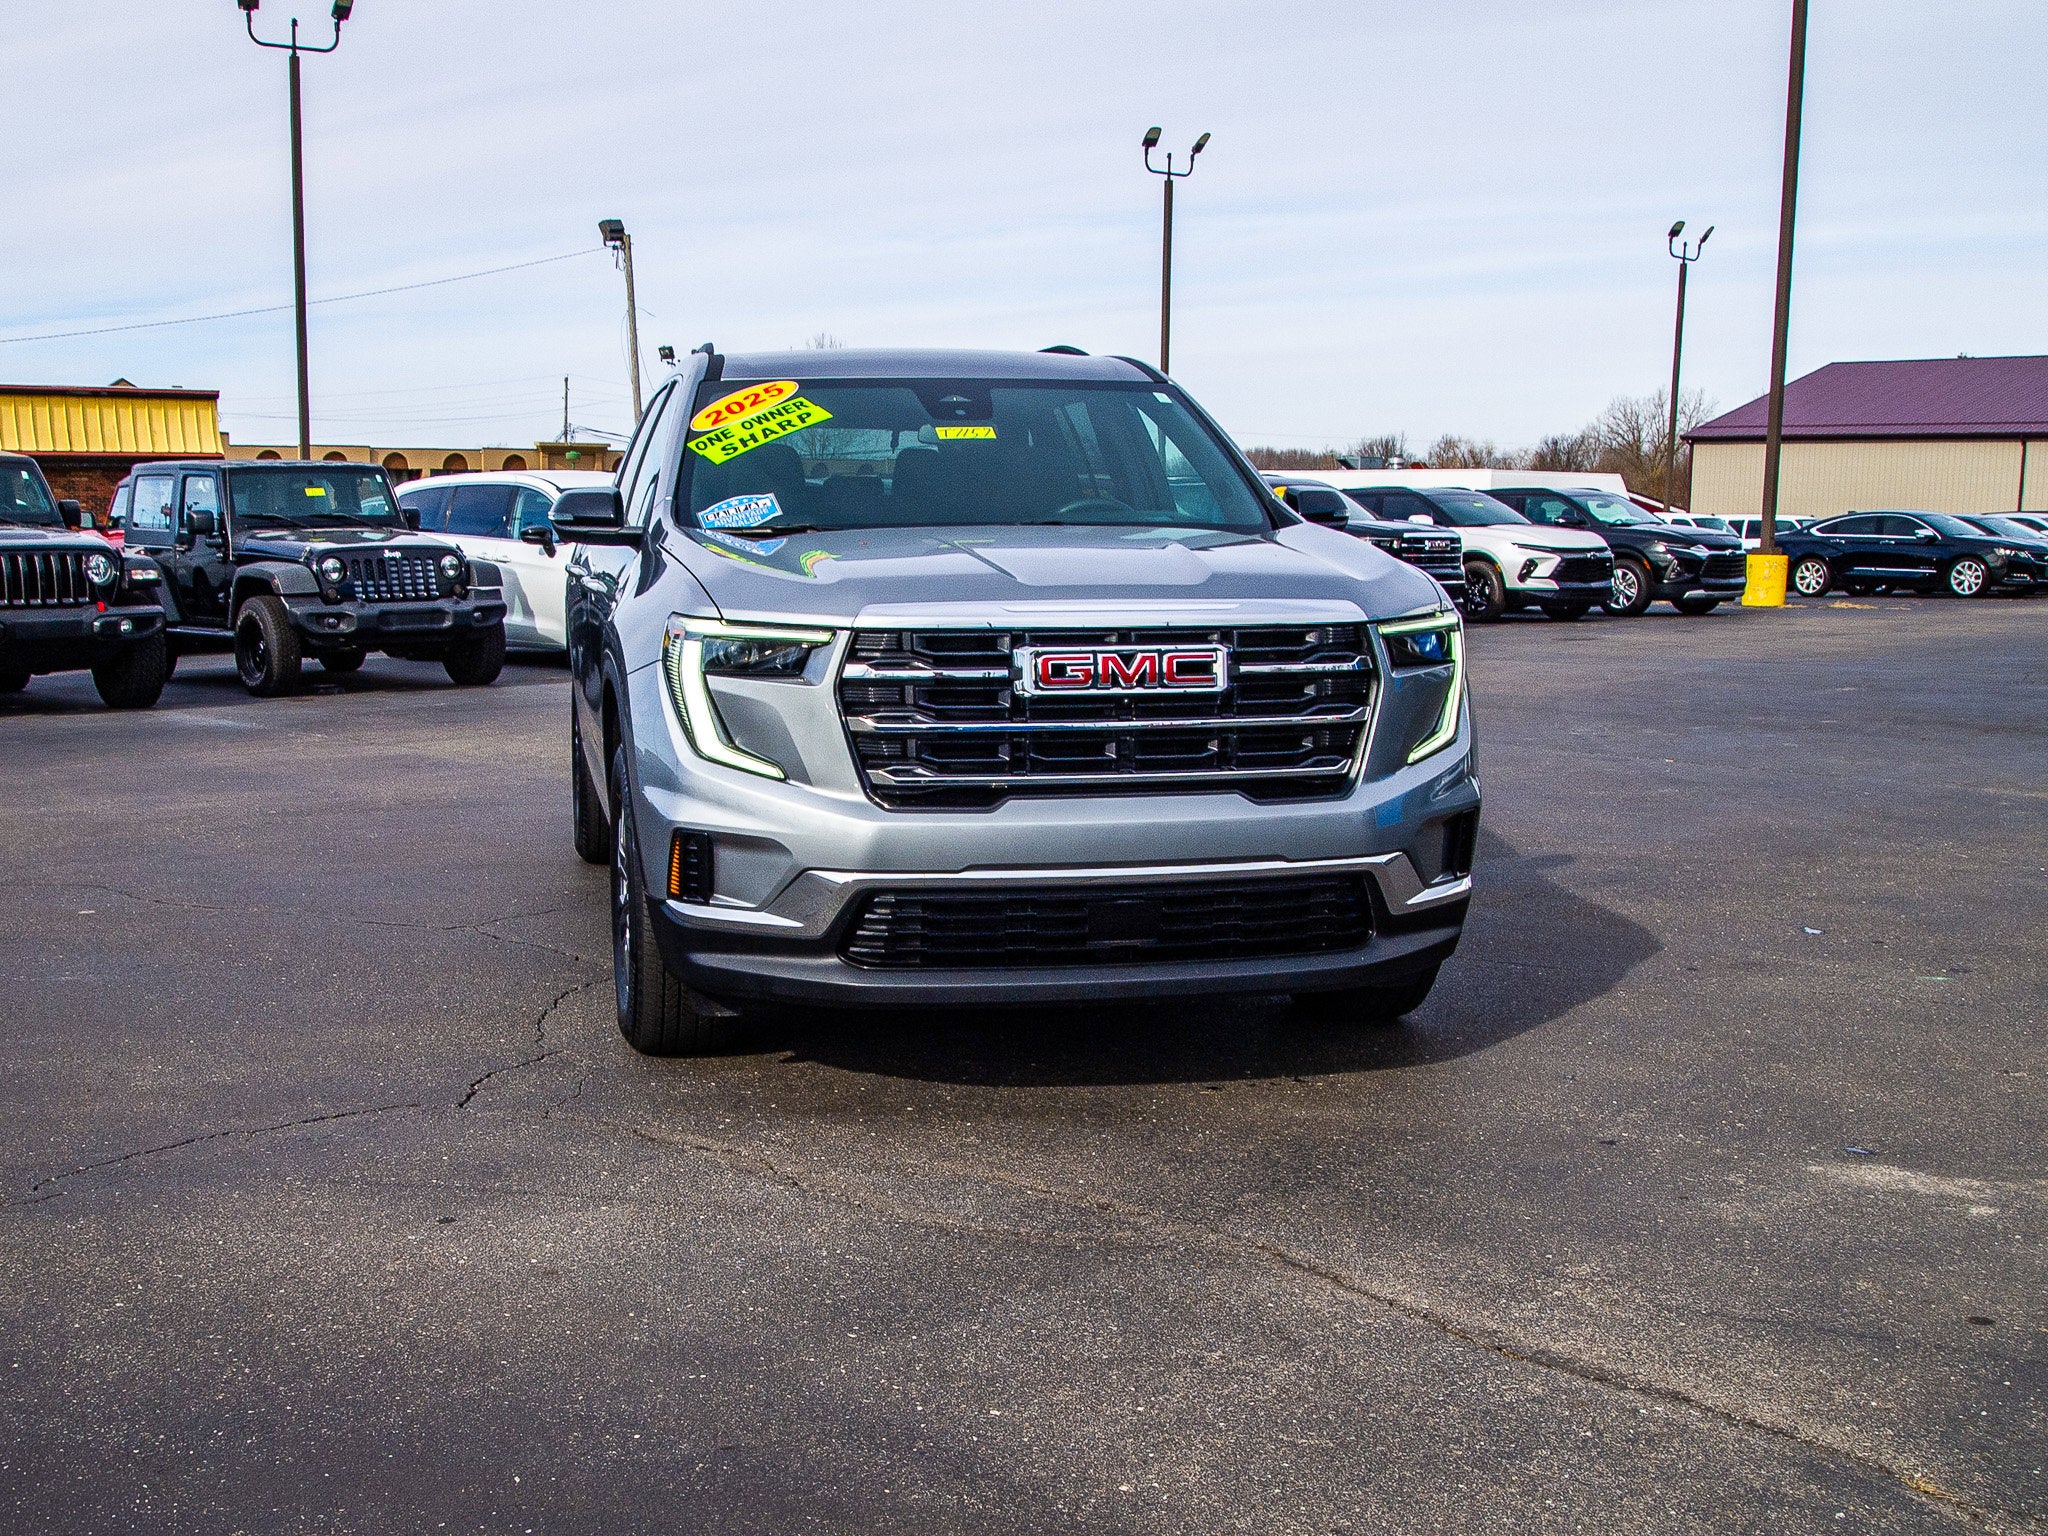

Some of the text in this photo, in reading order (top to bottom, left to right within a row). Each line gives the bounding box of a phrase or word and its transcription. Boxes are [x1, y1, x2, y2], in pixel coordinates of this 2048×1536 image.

[695, 400, 809, 451] ONE OWNER
[705, 384, 783, 426] 2025
[720, 411, 812, 456] SHARP
[1039, 652, 1218, 688] GMC
